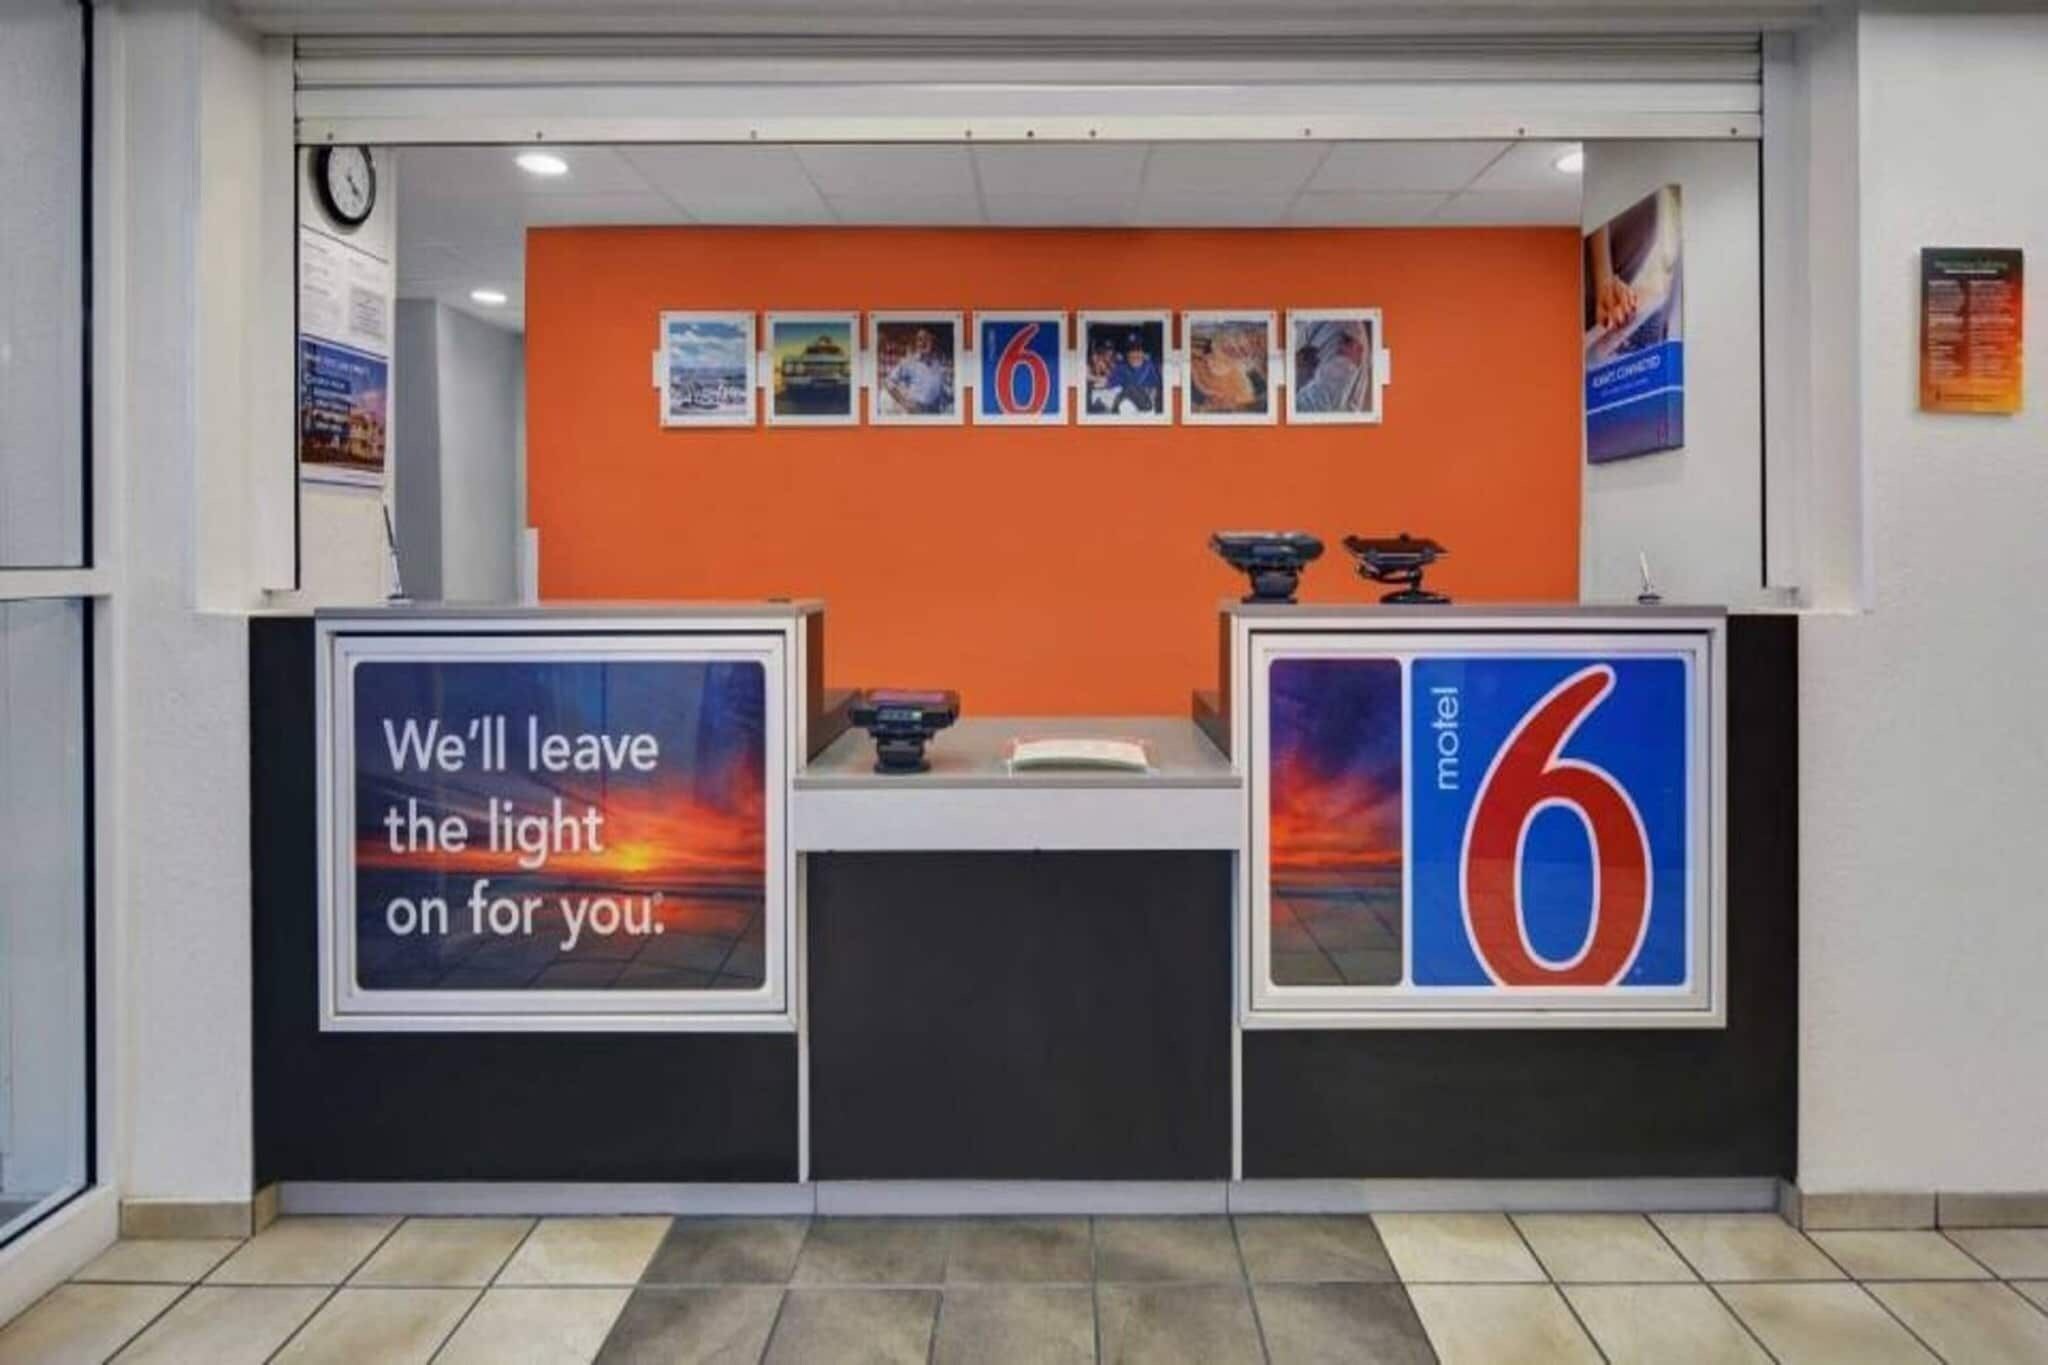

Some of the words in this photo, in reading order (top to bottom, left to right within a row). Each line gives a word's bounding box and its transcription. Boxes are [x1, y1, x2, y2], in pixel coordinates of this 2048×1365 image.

[995, 323, 1050, 416] 6
[383, 715, 506, 772] We'll
[528, 715, 659, 771] leave
[1431, 686, 1459, 790] motel
[384, 798, 468, 853] the
[489, 798, 604, 869] light
[1459, 663, 1653, 987] 6
[386, 897, 448, 935] on
[468, 880, 542, 935] for
